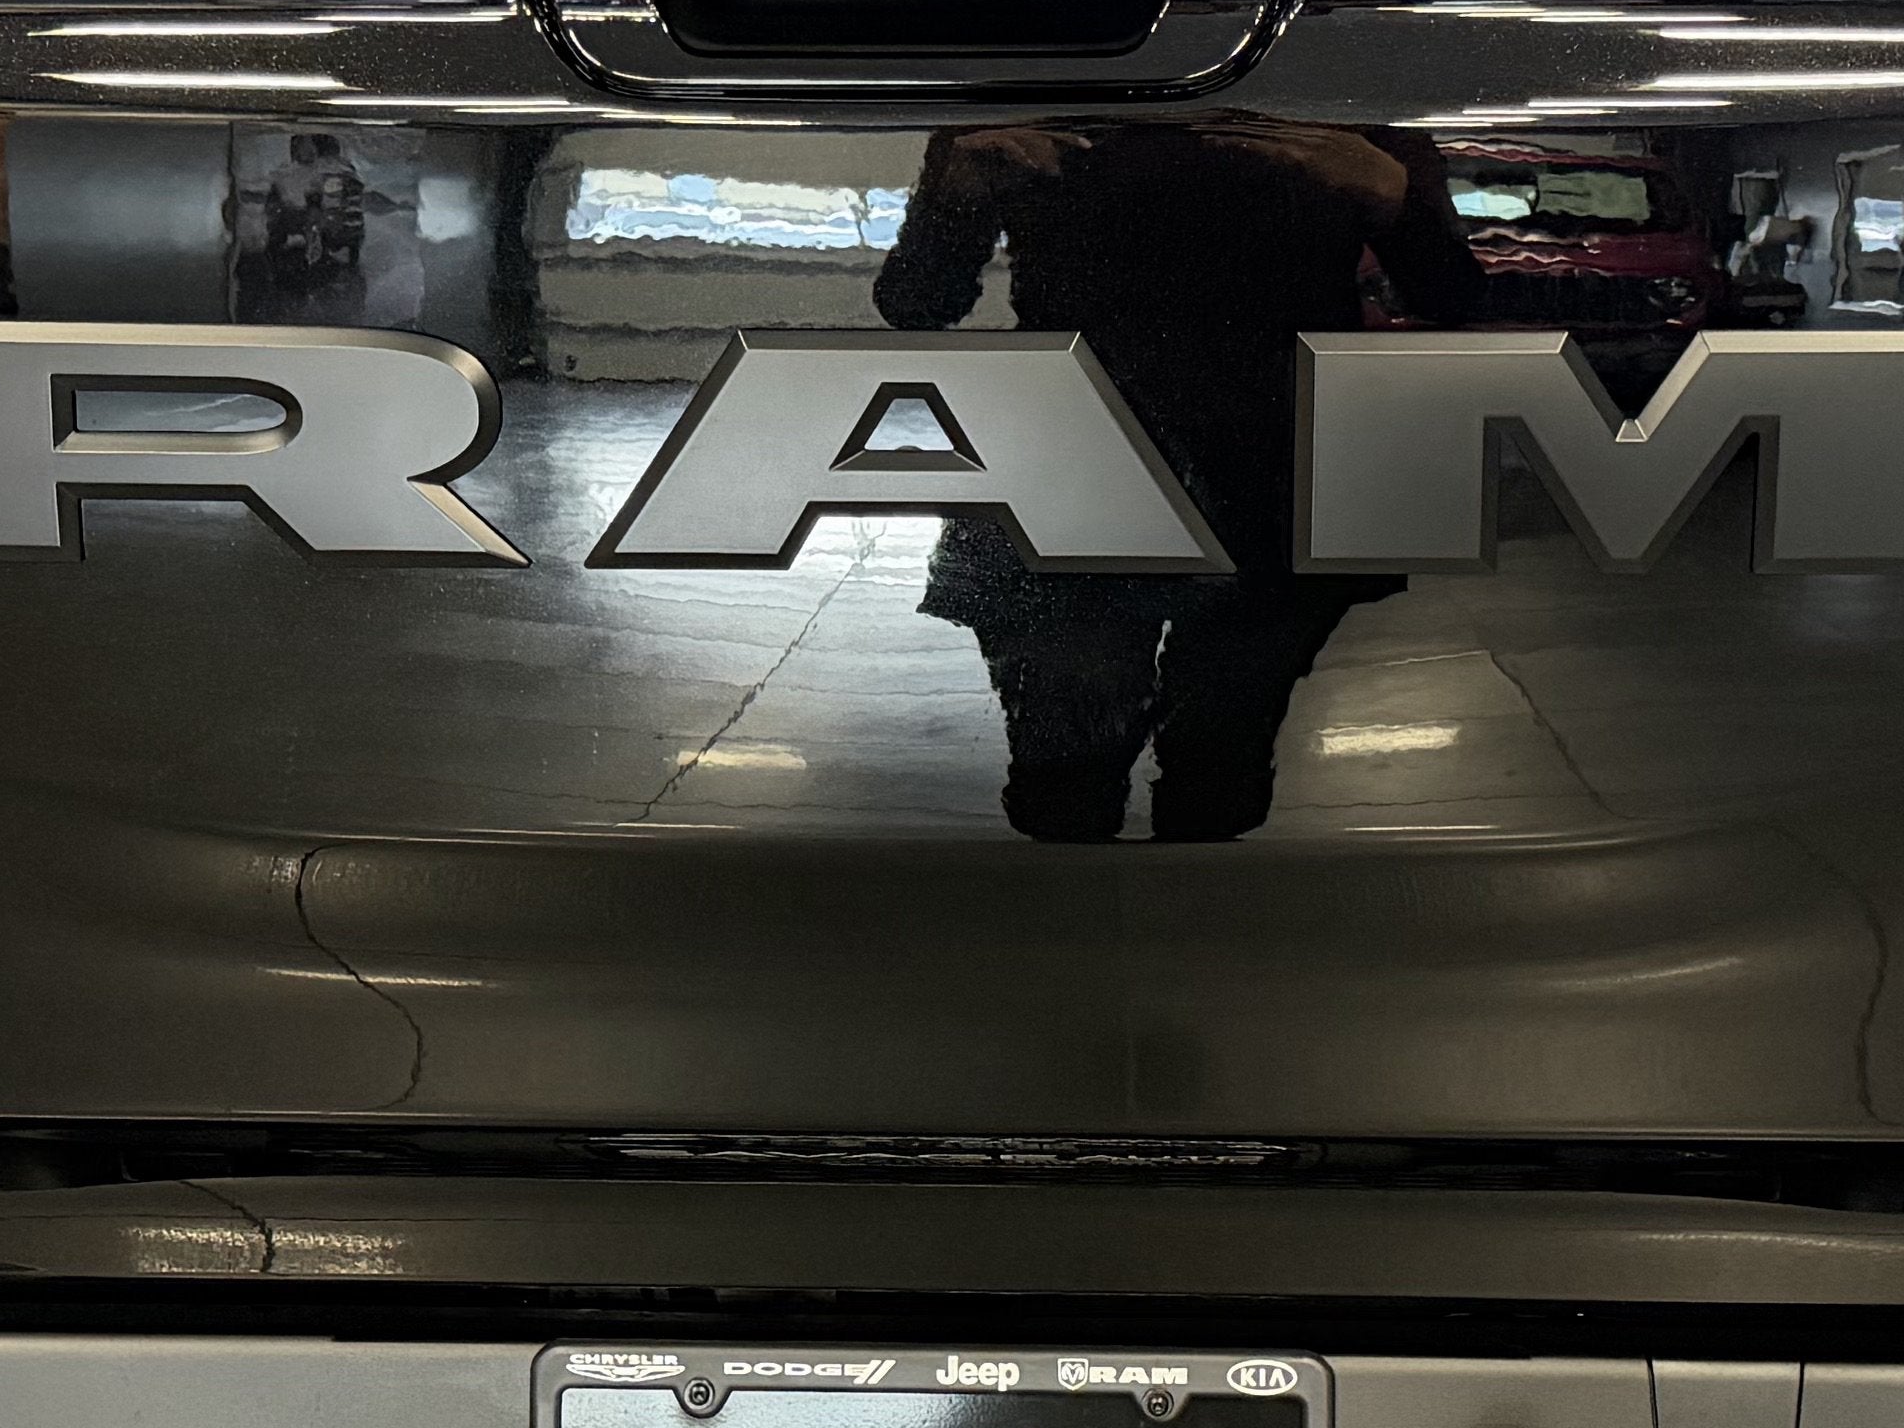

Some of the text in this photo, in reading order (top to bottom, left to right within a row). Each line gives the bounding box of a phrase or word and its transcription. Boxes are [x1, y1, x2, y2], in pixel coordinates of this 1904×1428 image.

[569, 1353, 679, 1366] CHRYSLER
[722, 1360, 879, 1378] DODGE
[935, 1355, 1020, 1392] Jeep
[1089, 1366, 1188, 1385] RAM
